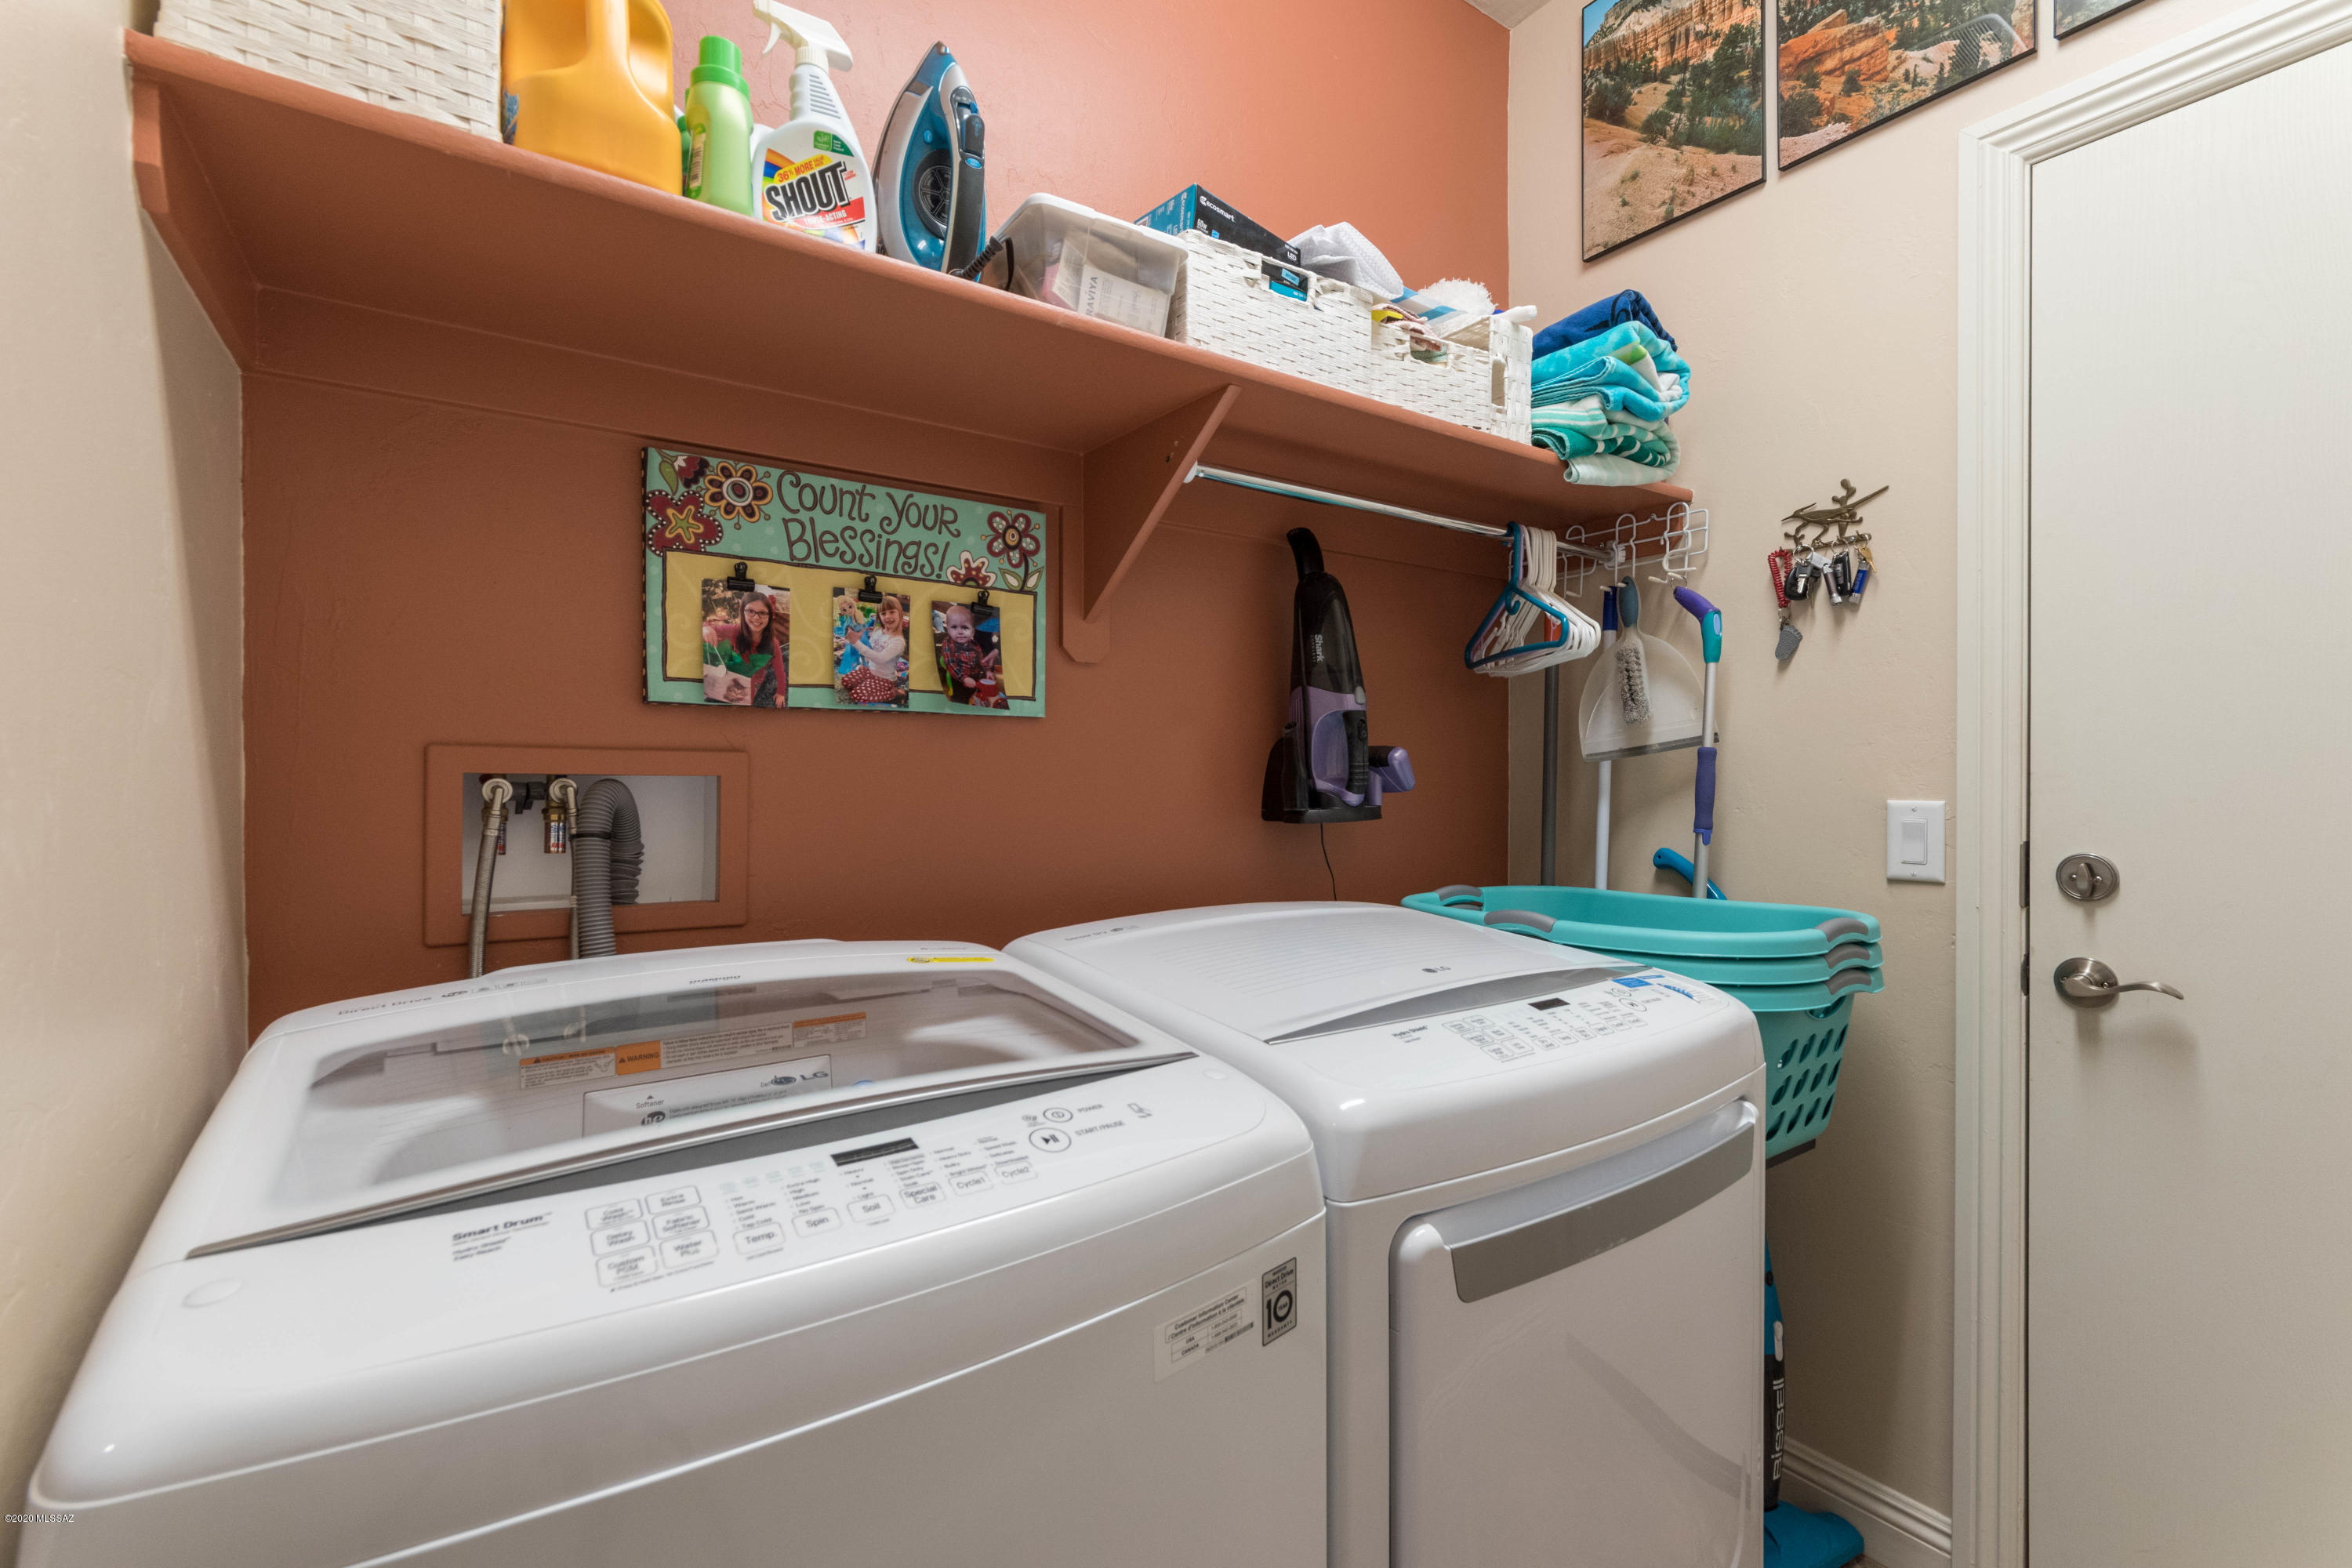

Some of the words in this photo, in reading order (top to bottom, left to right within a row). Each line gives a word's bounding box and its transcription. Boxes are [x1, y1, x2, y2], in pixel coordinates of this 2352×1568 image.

[777, 169, 794, 183] 36%
[794, 160, 814, 176] MORE
[765, 160, 851, 222] SHOUT
[1206, 199, 1236, 223] ecosmart
[1287, 251, 1297, 260] LED
[777, 470, 876, 523] Count
[782, 517, 950, 579] Blessings!
[1315, 633, 1323, 662] Shark
[627, 1052, 659, 1062] WARNING
[800, 1071, 829, 1080] LG
[1074, 1120, 1125, 1137] START/PAUSE
[1002, 1167, 1029, 1178] Cycle2
[903, 1185, 938, 1199] Special
[956, 1178, 985, 1189] Cycle1
[914, 1194, 936, 1204] Care
[862, 1203, 881, 1214] Soil
[452, 1225, 499, 1241] Smart
[503, 1215, 544, 1229] Drum
[805, 1217, 829, 1229] Spin
[1265, 1275, 1279, 1289] Direct
[1281, 1269, 1294, 1279] Drive
[1266, 1290, 1294, 1330] 10
